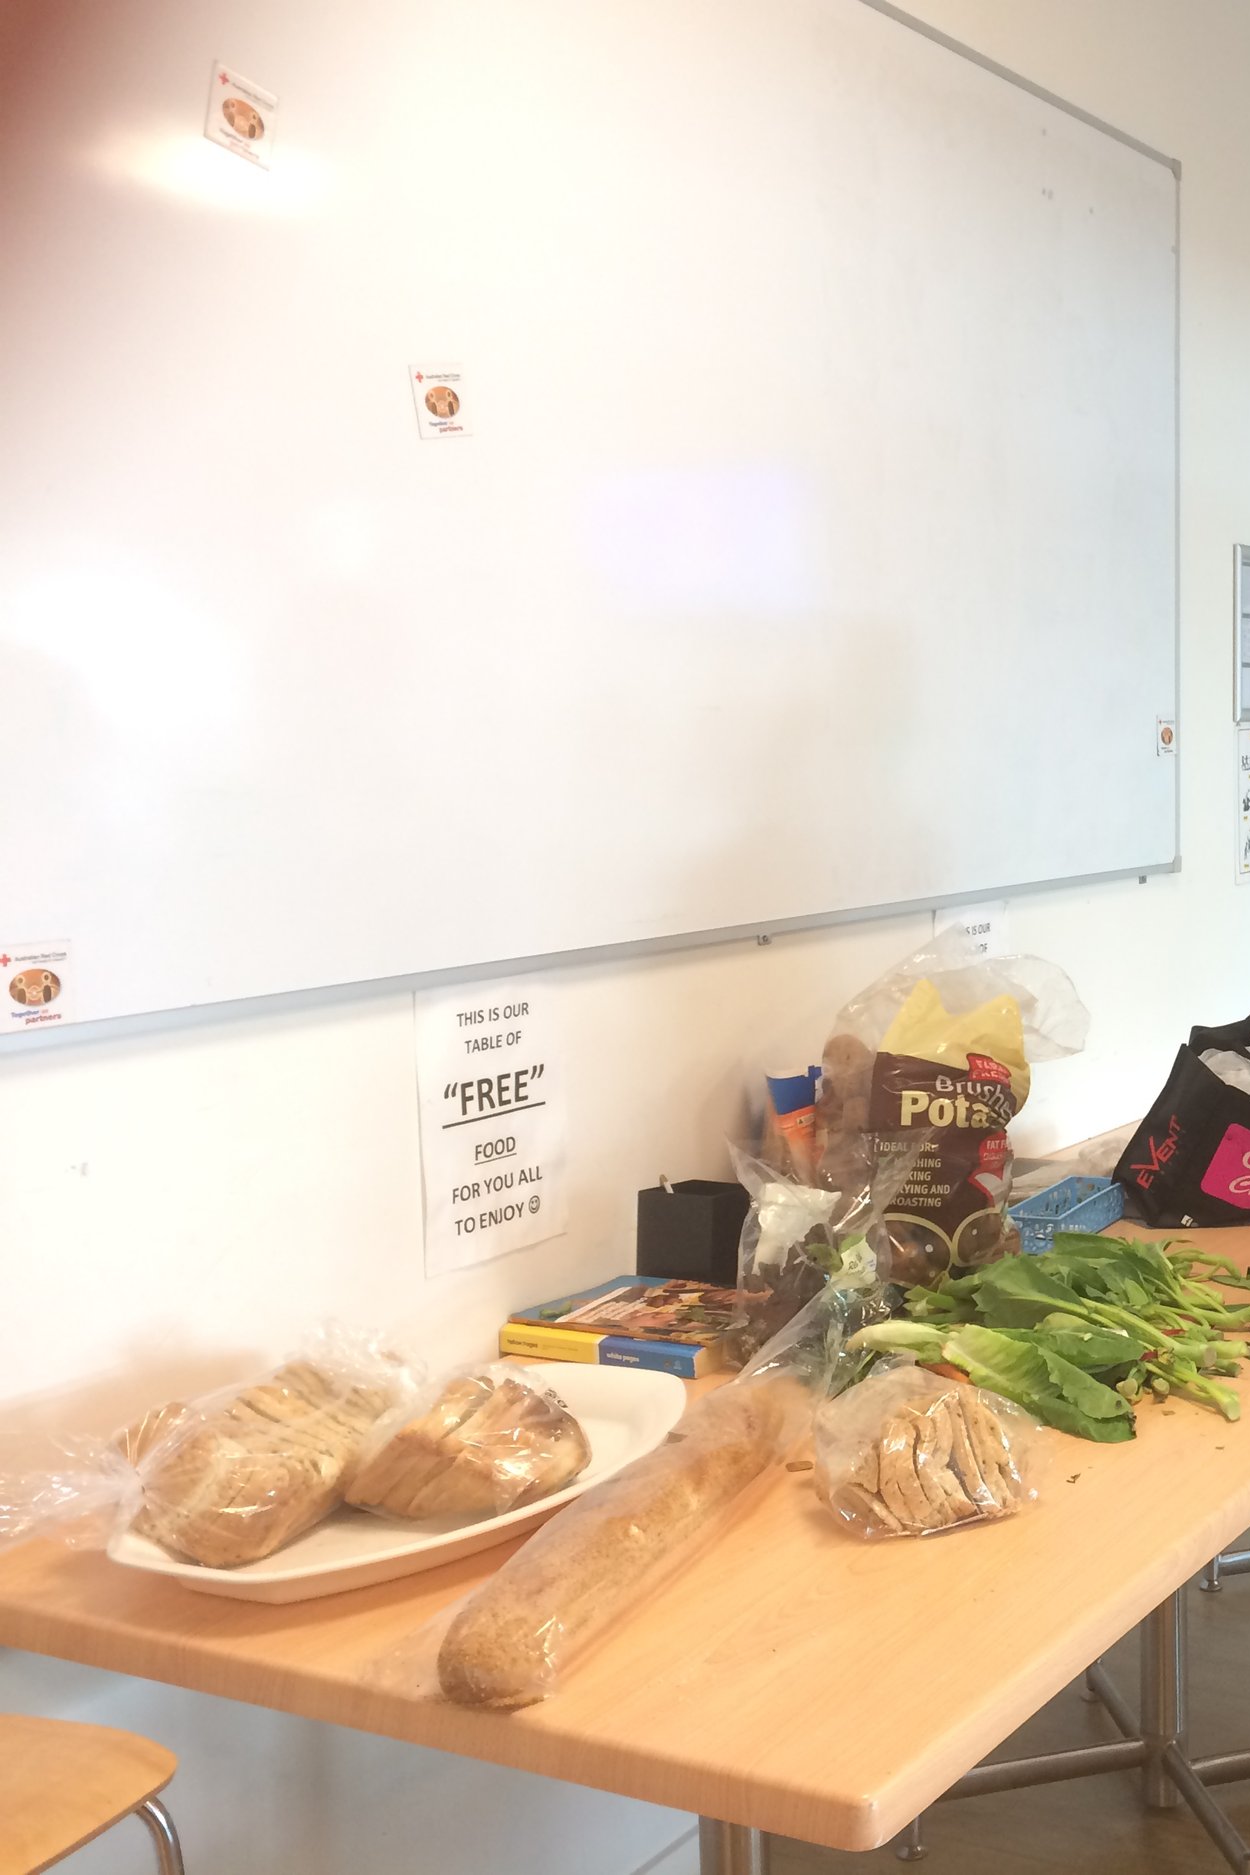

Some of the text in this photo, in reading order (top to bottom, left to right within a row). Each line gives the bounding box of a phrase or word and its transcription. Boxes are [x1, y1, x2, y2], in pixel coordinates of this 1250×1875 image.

[456, 1002, 529, 1027] THIS IS OUR
[464, 1030, 522, 1054] TABLE OF
[901, 1090, 991, 1129] Pota
[475, 1136, 516, 1161] FOOD
[452, 1165, 543, 1204] FOR YOU ALL
[930, 1185, 951, 1194] AND
[454, 1201, 525, 1236] TO ENJOY
